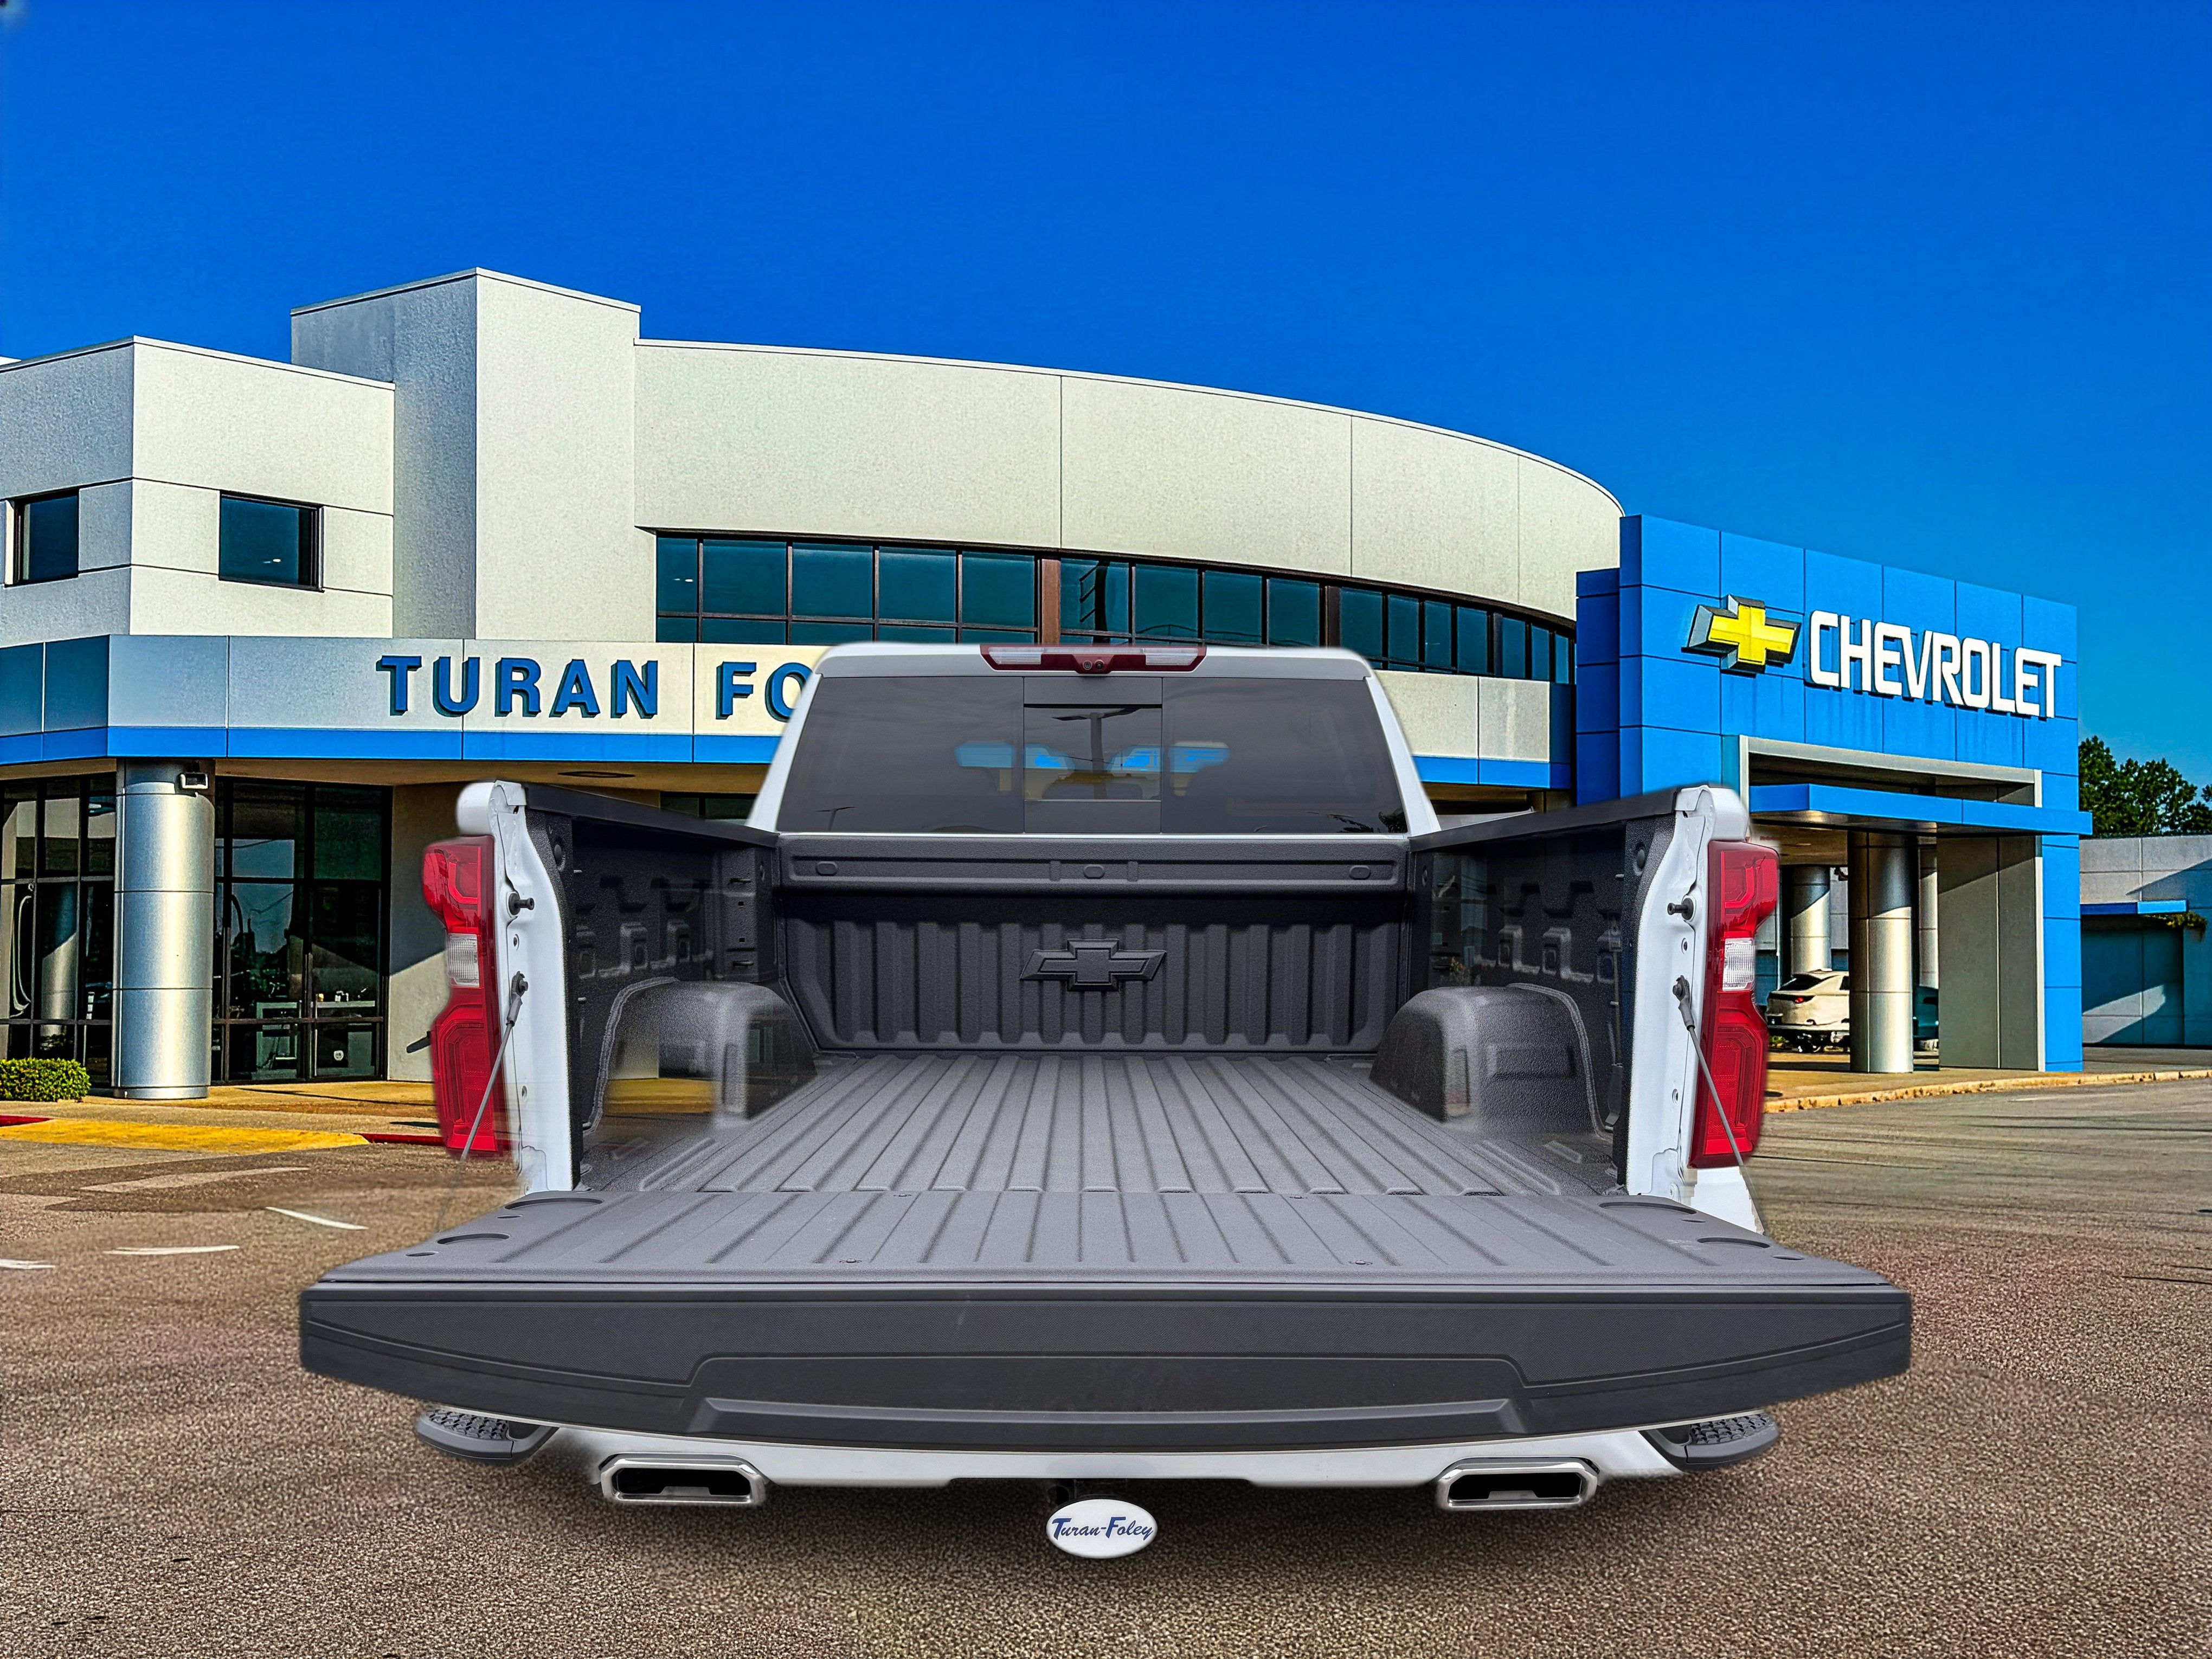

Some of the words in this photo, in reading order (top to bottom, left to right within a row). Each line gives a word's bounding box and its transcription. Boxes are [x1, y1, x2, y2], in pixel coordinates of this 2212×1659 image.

[376, 655, 658, 719] TURAN
[1809, 610, 2062, 719] CHEVROLET
[1052, 1516, 1153, 1540] Turan-Foley
